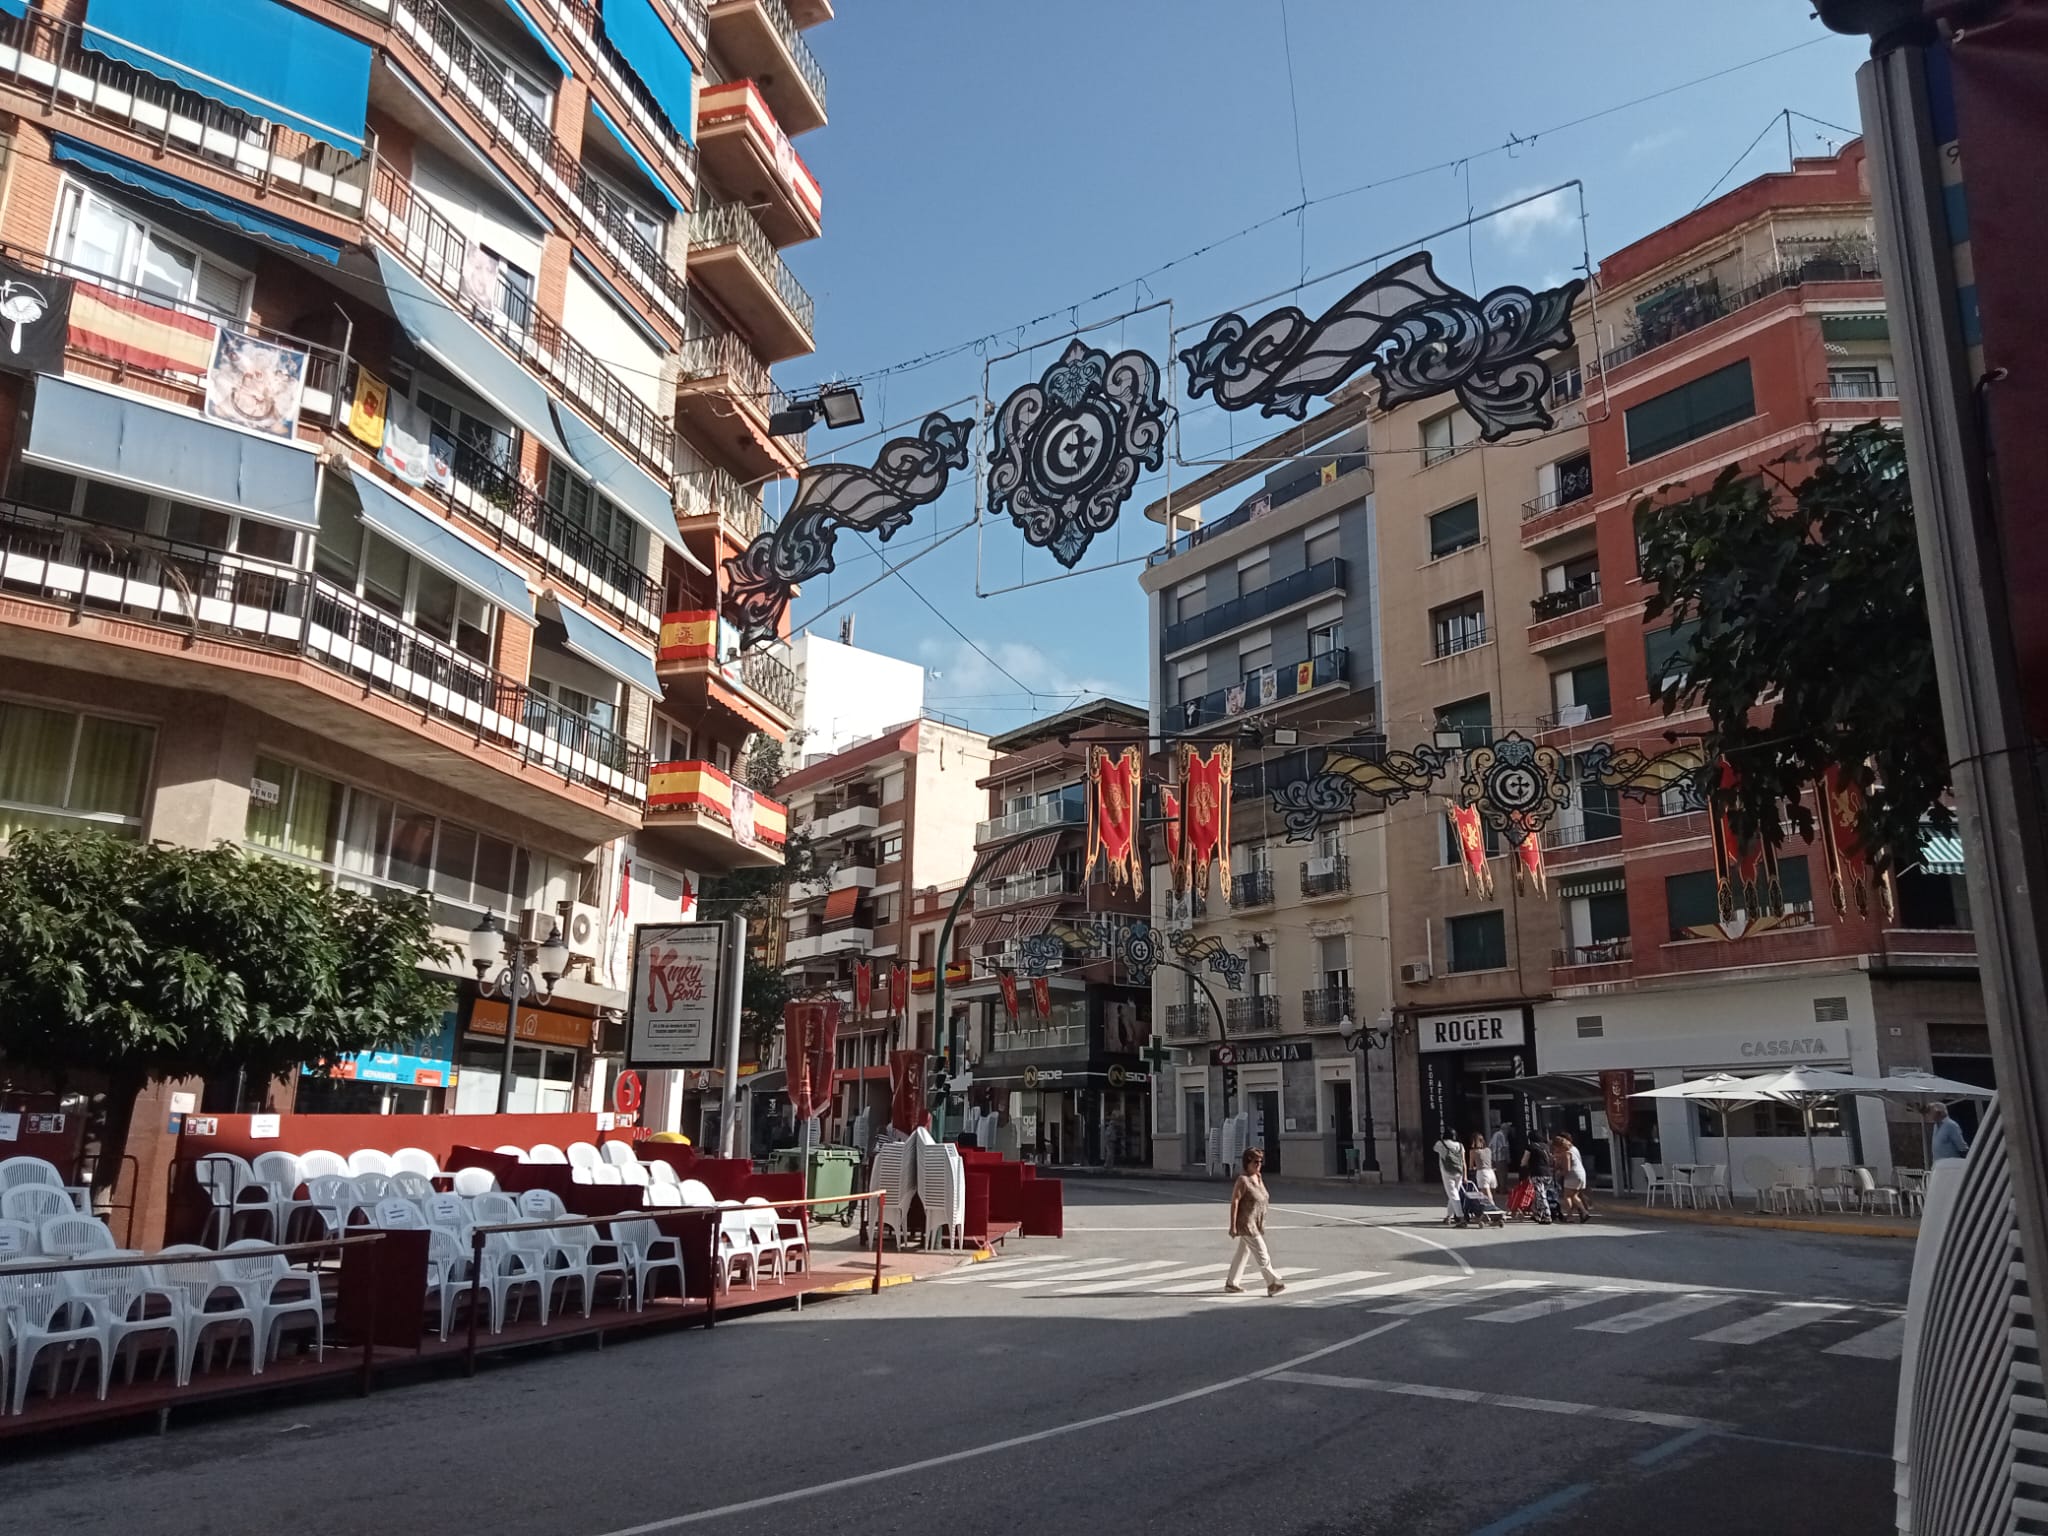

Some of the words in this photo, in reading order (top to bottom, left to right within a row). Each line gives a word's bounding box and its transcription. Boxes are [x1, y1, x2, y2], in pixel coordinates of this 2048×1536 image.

[672, 983, 707, 1001] Boots
[1435, 1018, 1503, 1043] ROGER
[1236, 1045, 1299, 1062] RMACIA
[1740, 1038, 1829, 1057] CASSATA
